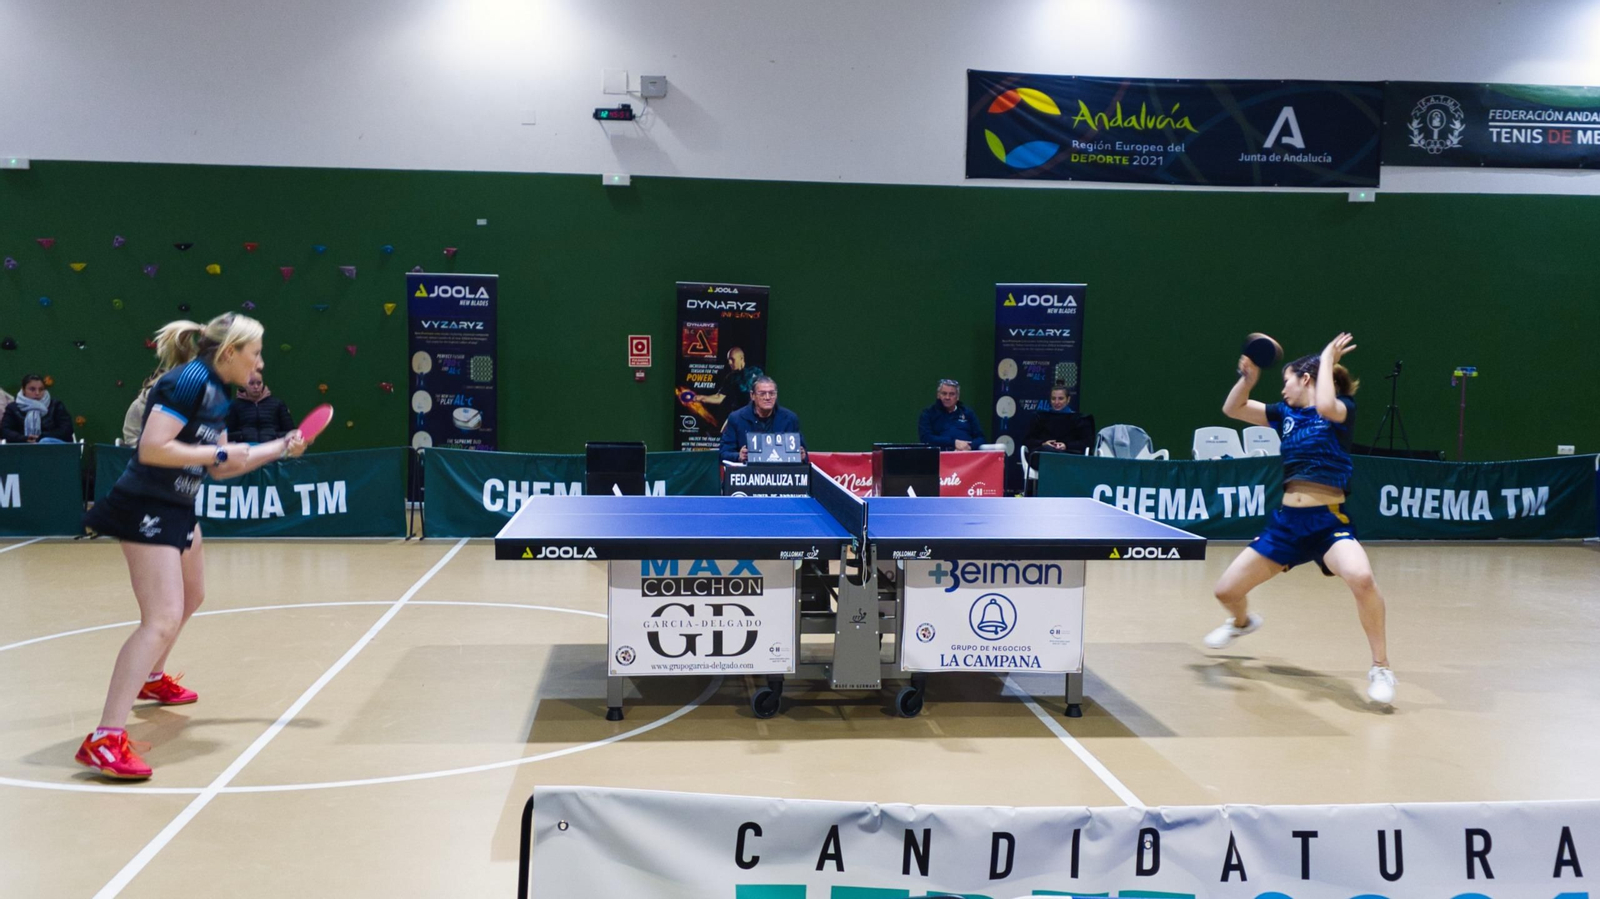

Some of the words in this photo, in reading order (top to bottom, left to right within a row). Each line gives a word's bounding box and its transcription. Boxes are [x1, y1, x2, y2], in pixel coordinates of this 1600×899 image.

[1071, 99, 1199, 133] Andalucía
[1488, 109, 1564, 121] FEDERACIÓN
[1565, 111, 1600, 122] ANDA
[1488, 128, 1543, 144] TENIS
[1548, 129, 1572, 144] DE
[1071, 139, 1112, 152] Región
[1115, 141, 1164, 154] Europea
[1167, 142, 1185, 153] del
[1070, 153, 1130, 165] DEPORTE
[1132, 155, 1164, 166] 2021
[1238, 153, 1267, 164] Junta
[1268, 153, 1281, 163] de
[1283, 153, 1332, 164] Andalucía
[429, 285, 490, 299] JOOLA
[686, 299, 757, 311] DYNARYZ
[1018, 294, 1077, 307] JOOLA
[421, 320, 484, 329] VYZARYZ
[1009, 328, 1071, 337] VYZARYZ
[686, 373, 713, 382] POWER
[730, 473, 793, 486] FED.ANDALUZA
[294, 481, 347, 516] TM
[1217, 484, 1265, 518] TM
[1379, 484, 1494, 521] CHEMA
[1501, 486, 1550, 519] TM
[536, 546, 598, 559] JOOLA
[1122, 547, 1181, 559] JOOLA
[643, 578, 763, 597] COLCHON
[642, 619, 763, 629] GARCIA-DELGADO
[650, 661, 754, 671] www.grupogarcia-delgado.com
[940, 653, 960, 667] LA
[963, 653, 1042, 669] CAMPANA
[735, 821, 1584, 882] CANDIDATURA
